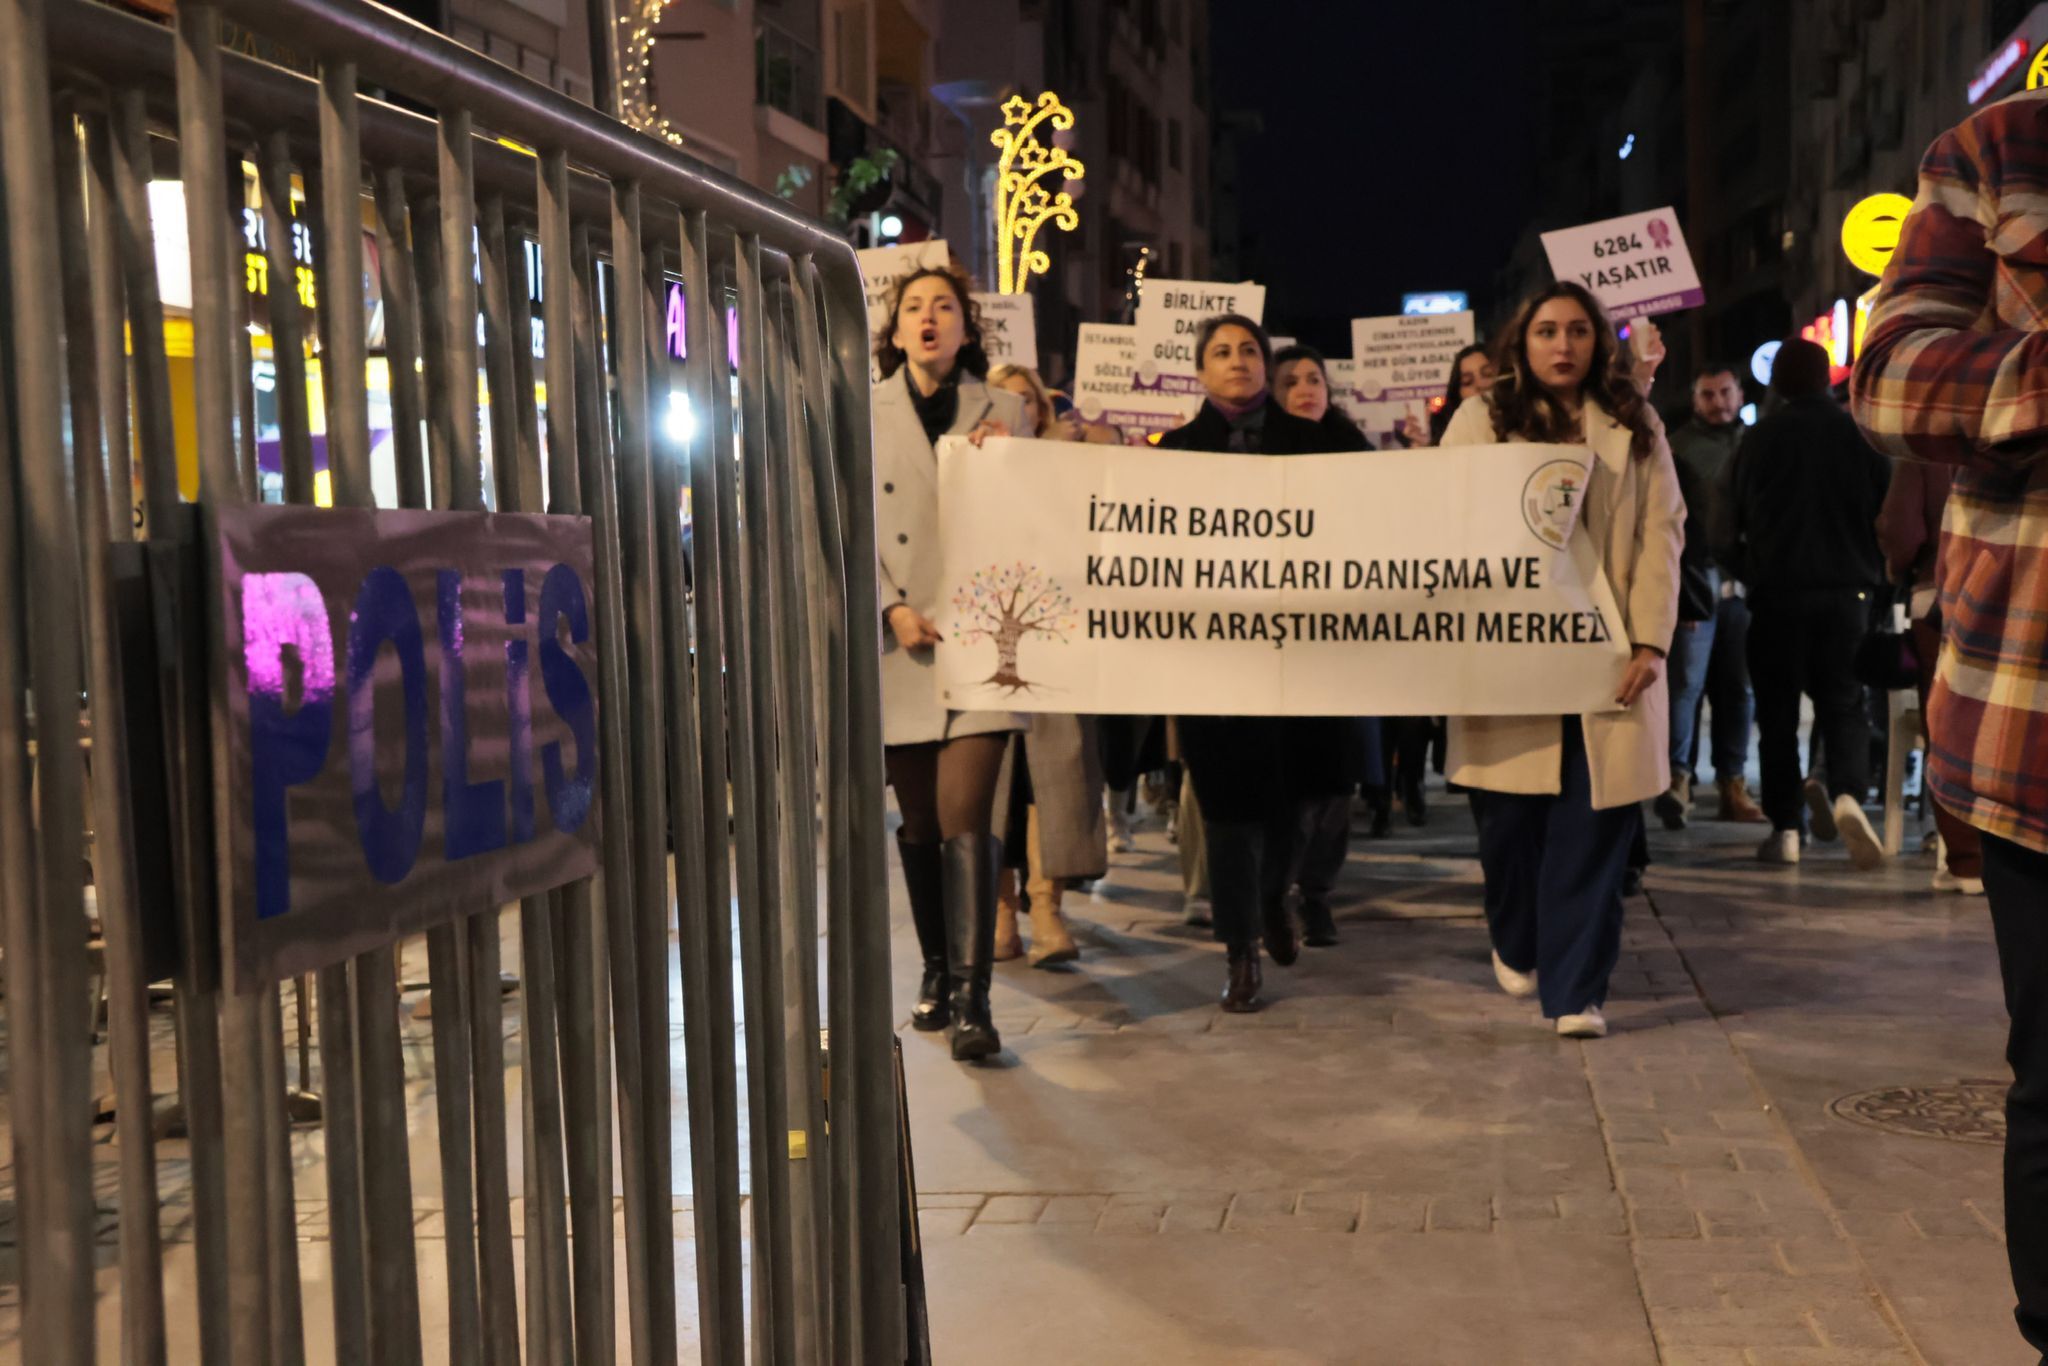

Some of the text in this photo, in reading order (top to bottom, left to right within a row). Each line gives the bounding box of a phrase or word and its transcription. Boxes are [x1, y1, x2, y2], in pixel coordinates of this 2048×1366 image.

[1594, 233, 1642, 257] 6284
[1581, 256, 1672, 290] YAŞATIR
[1164, 289, 1236, 312] BİRLİKTE
[1363, 358, 1387, 368] HER
[1392, 353, 1417, 366] GÜN
[1392, 367, 1440, 382] ÖLÜYOR
[1089, 494, 1314, 538] İZMİR BAROSU
[1087, 555, 1540, 598] KADIN HAKLARI DANIŞMA VE
[1088, 609, 1197, 640] HUKUK
[1206, 611, 1465, 649] ARAŞTIRMALARI
